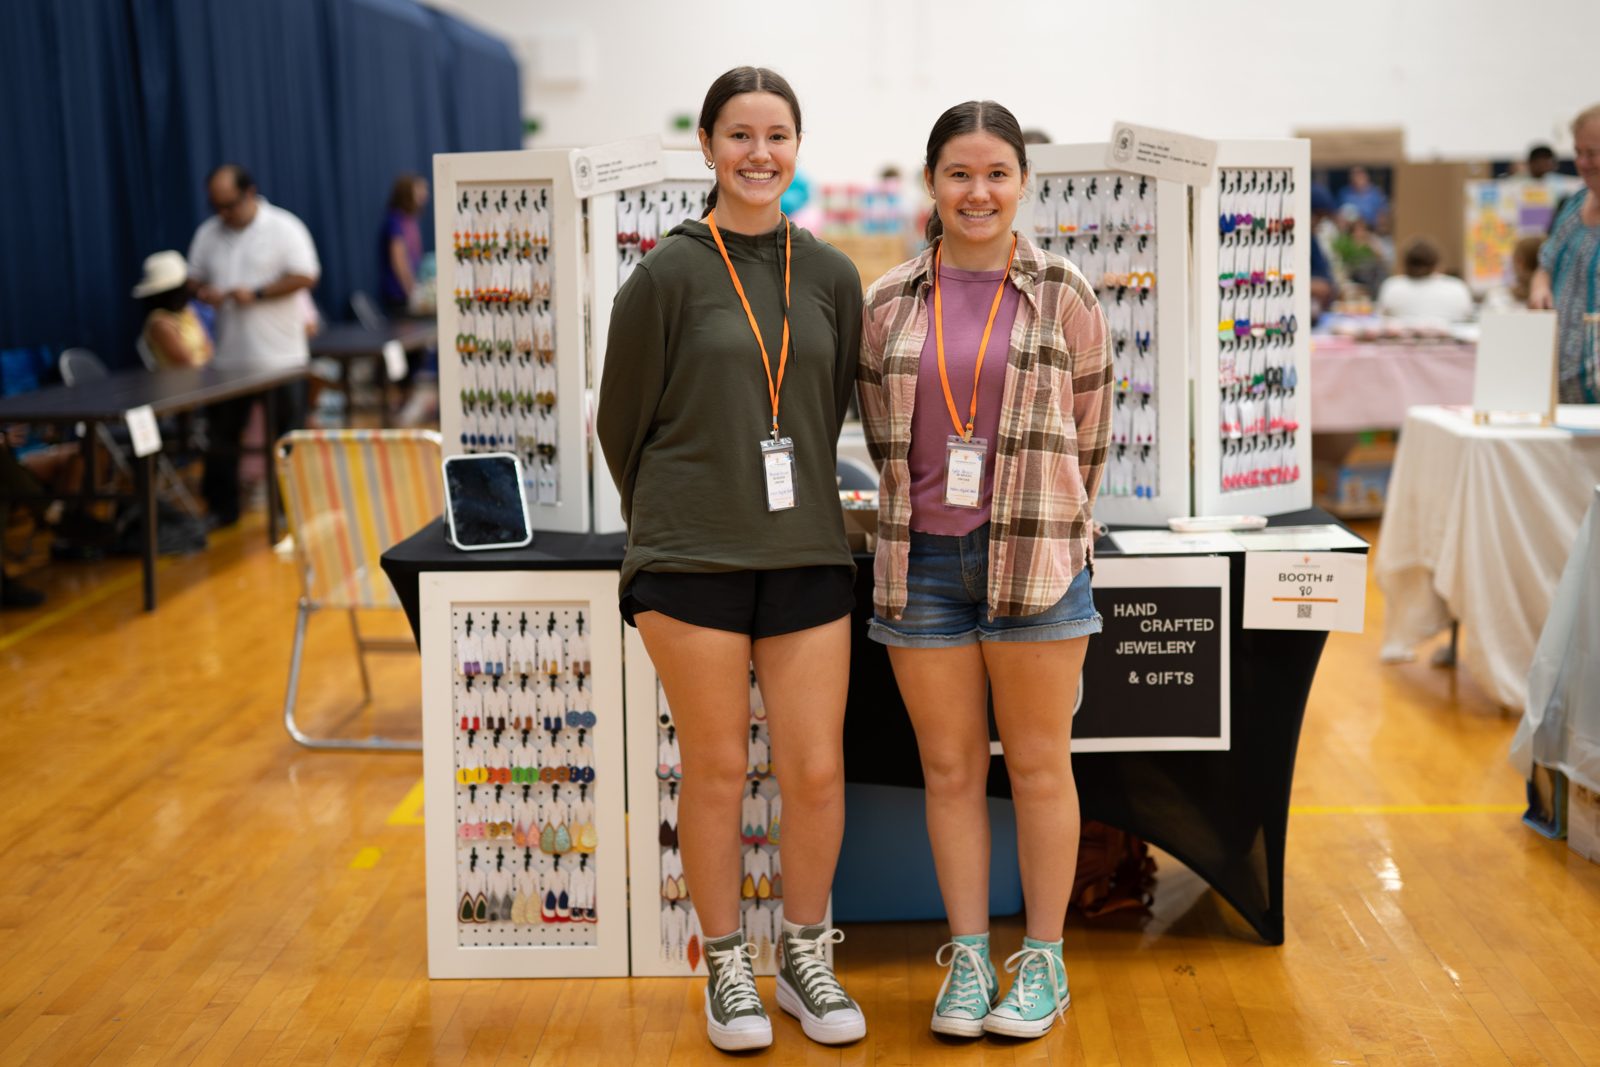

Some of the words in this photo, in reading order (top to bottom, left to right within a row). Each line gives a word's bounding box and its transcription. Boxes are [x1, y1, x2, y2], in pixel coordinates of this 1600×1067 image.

[1278, 573, 1322, 583] BOOTH
[1326, 574, 1334, 582] #
[1114, 603, 1158, 617] HAND
[1140, 618, 1215, 632] CRAFTED
[1115, 641, 1196, 655] JEWELERY
[1128, 671, 1140, 684] &
[1146, 671, 1194, 685] GIFTS
